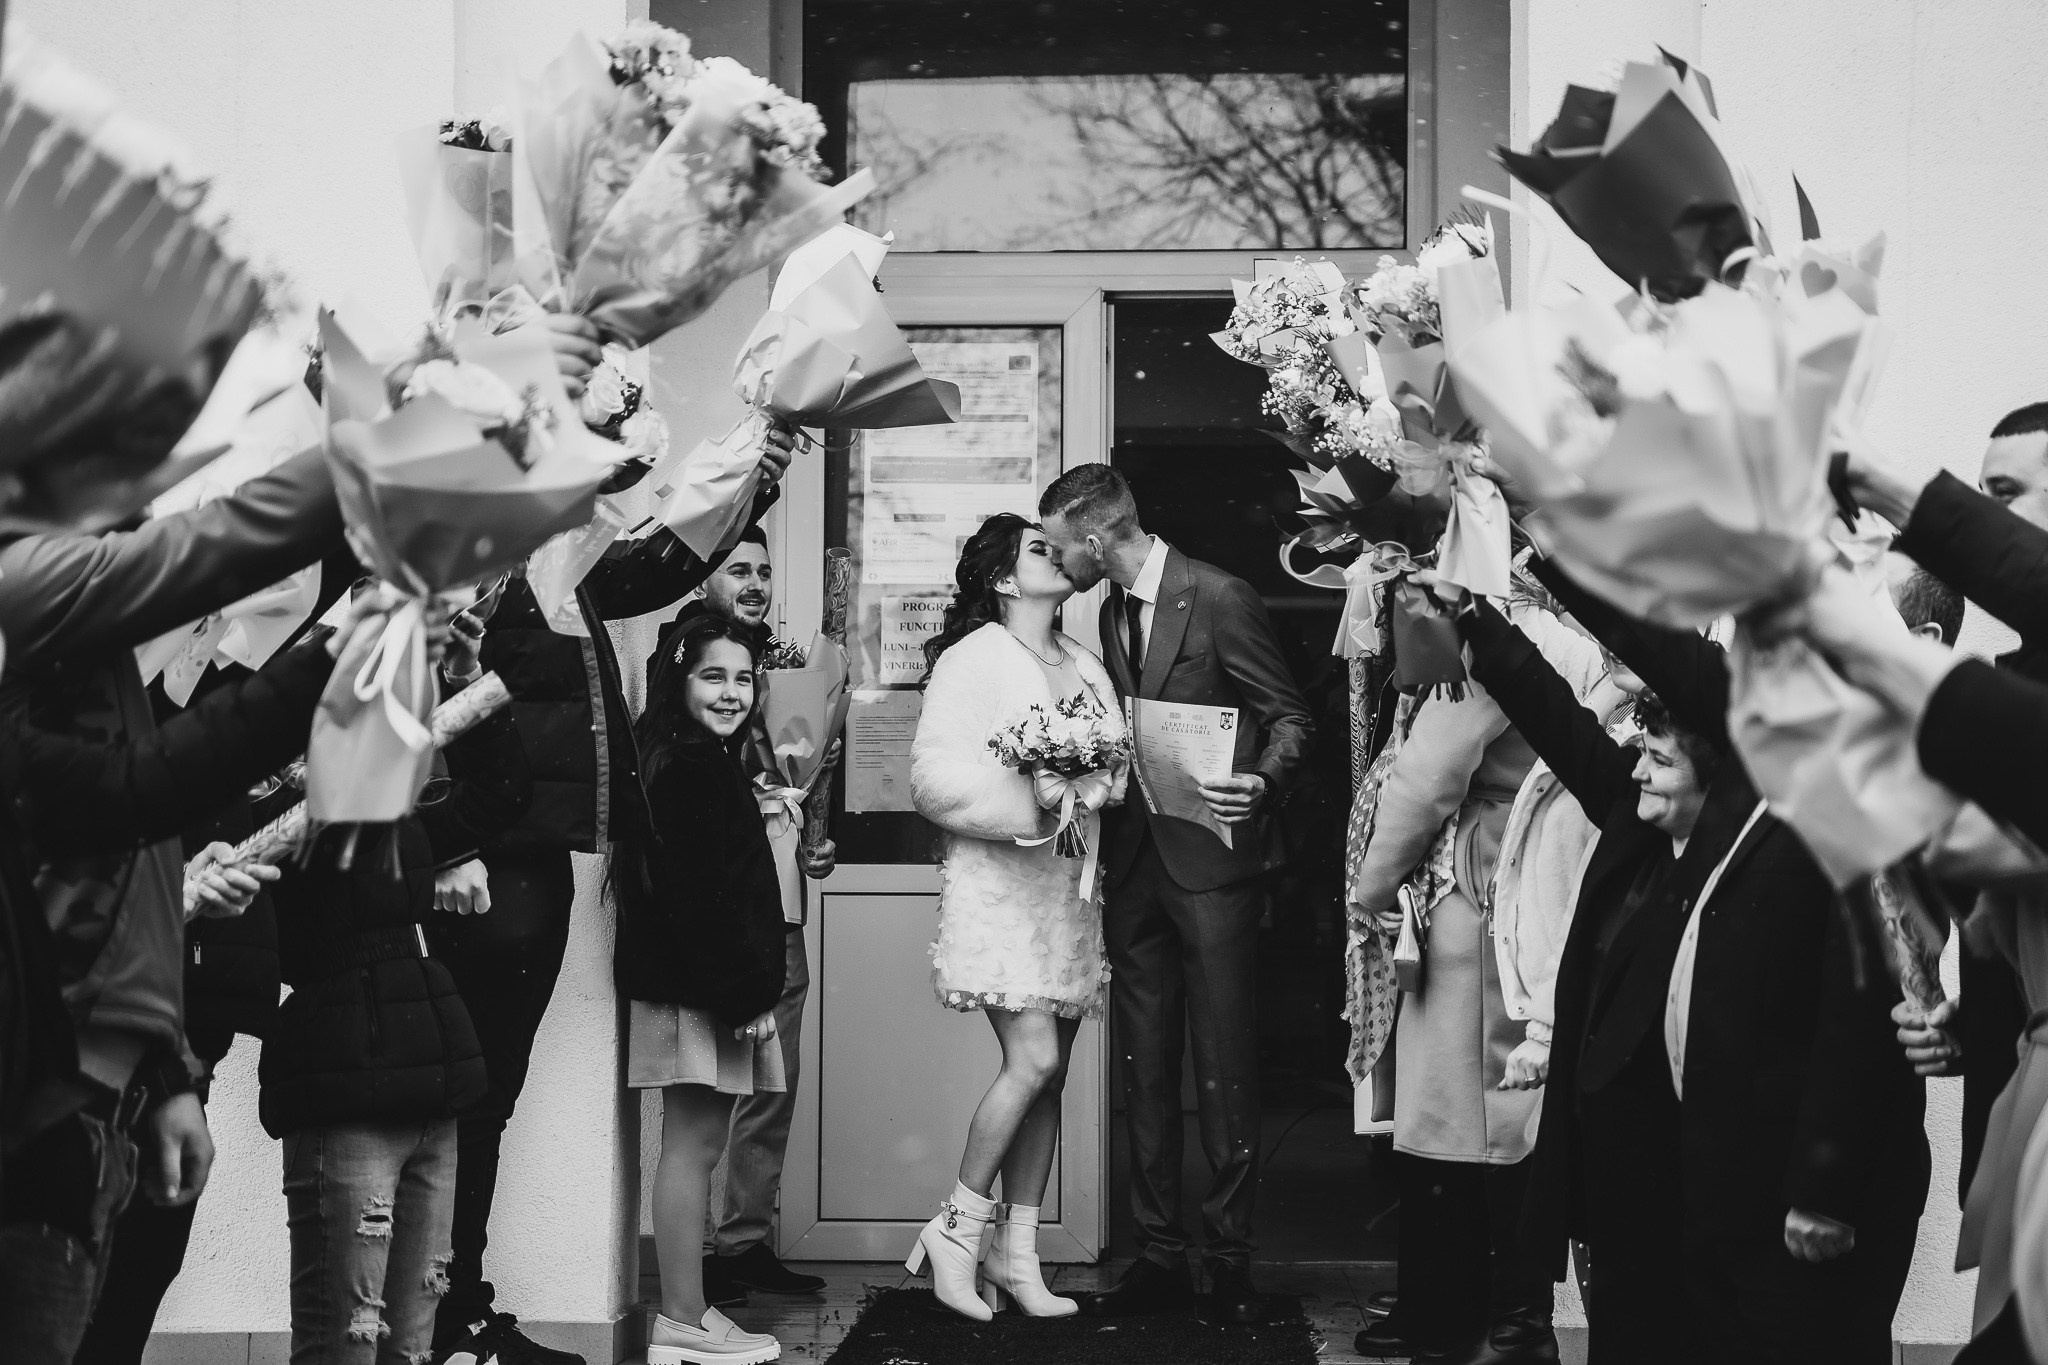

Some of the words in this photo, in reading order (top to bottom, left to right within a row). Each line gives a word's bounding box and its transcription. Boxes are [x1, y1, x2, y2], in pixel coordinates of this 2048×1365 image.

[903, 602, 944, 611] PROGR
[900, 622, 943, 633] FUNCȚI
[884, 643, 908, 651] LUNI
[884, 662, 923, 670] VINERI:
[1164, 721, 1208, 730] CERTIFICAT
